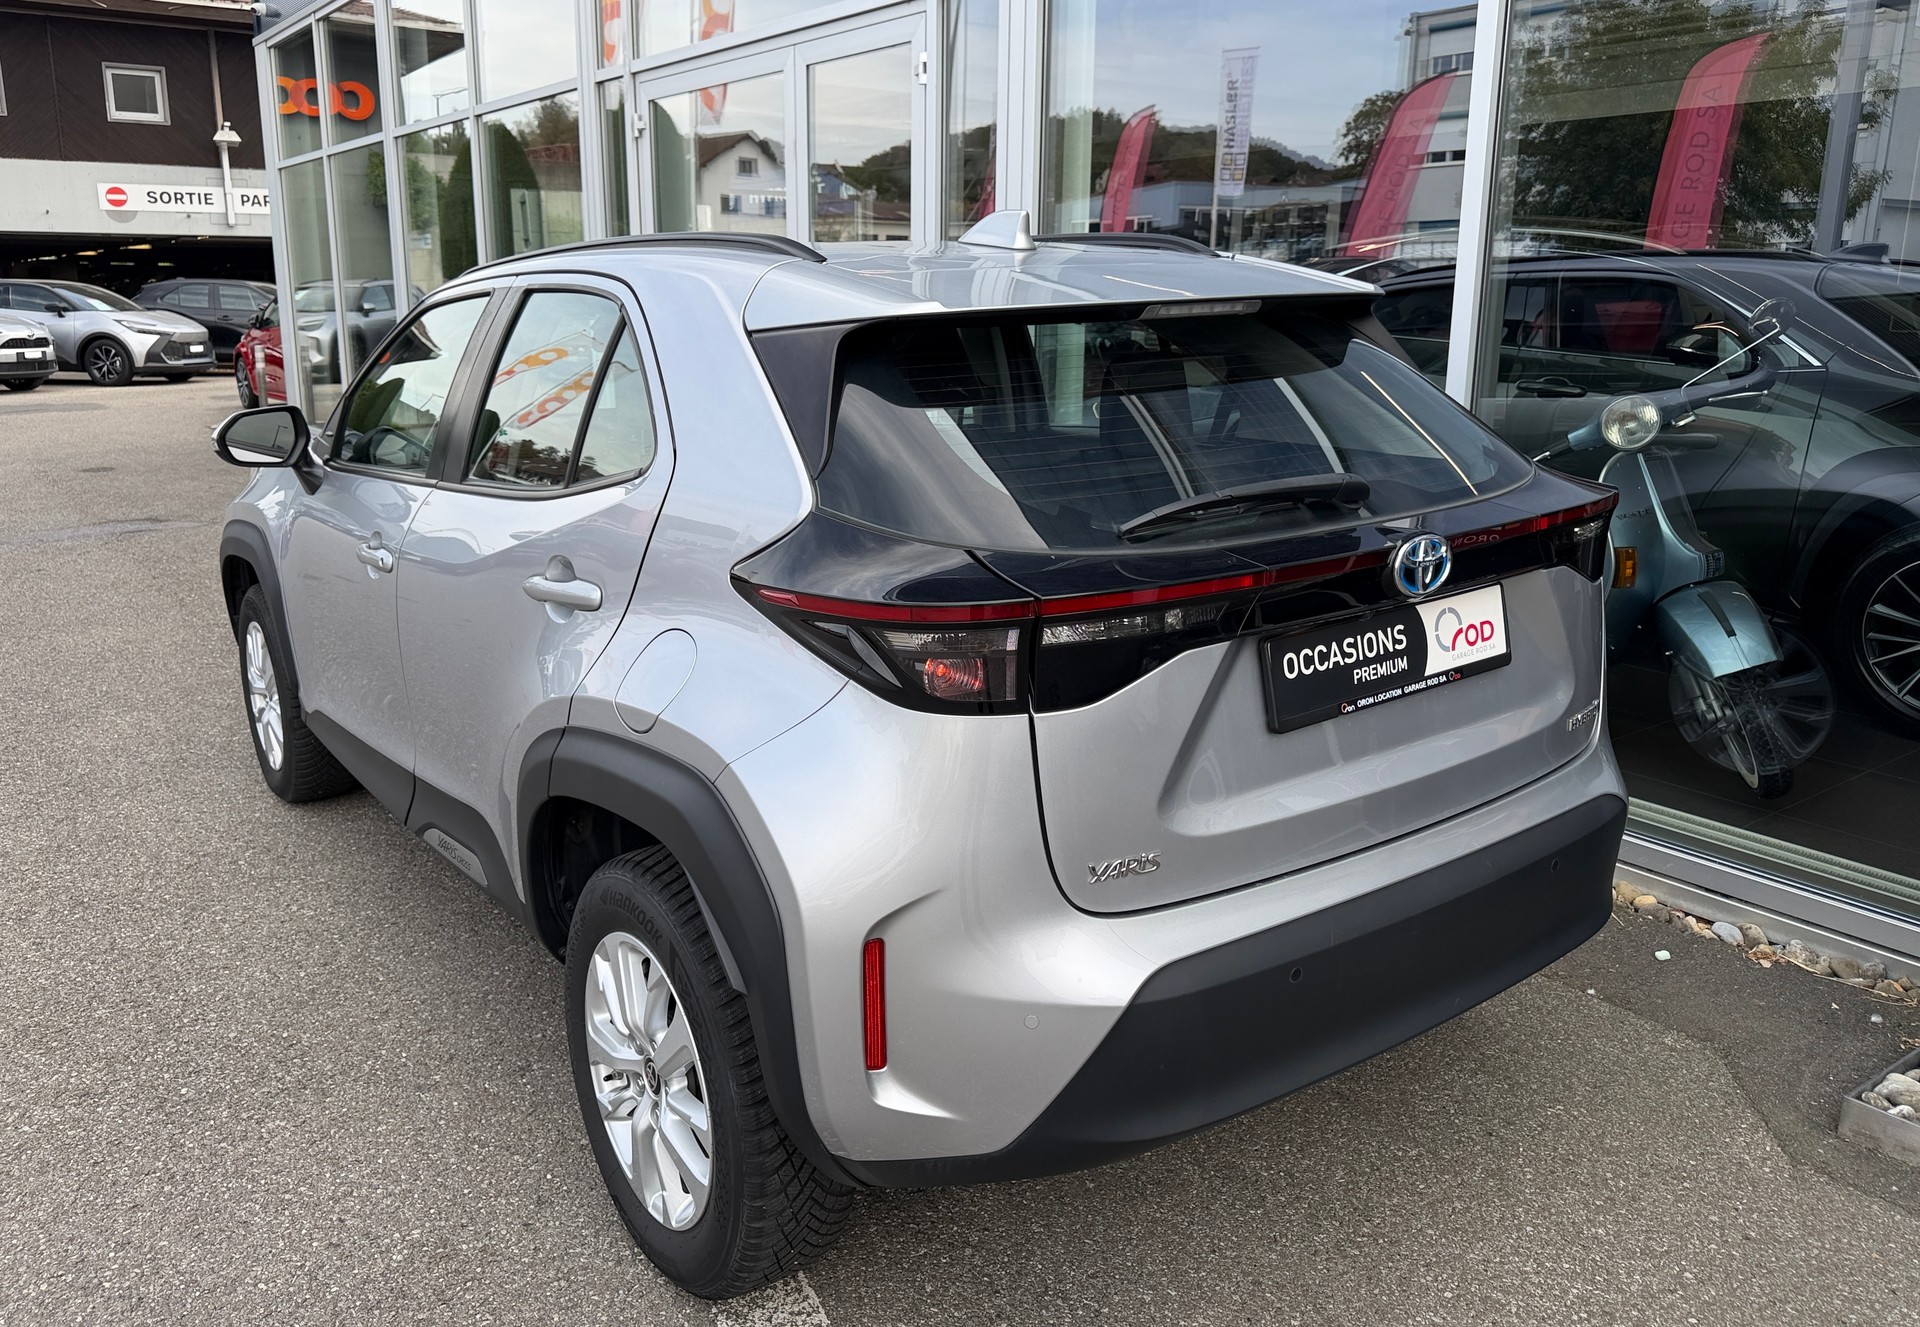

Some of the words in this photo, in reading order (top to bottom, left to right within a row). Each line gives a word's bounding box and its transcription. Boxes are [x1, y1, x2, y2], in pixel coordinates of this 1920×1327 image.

[1222, 79, 1239, 149] HASLER
[1680, 131, 1710, 191] ROD
[1696, 84, 1723, 120] SA
[146, 190, 215, 206] SORTIE
[1384, 155, 1411, 201] ROD
[1282, 624, 1408, 680] OCCASIONS
[1353, 655, 1409, 685] PREMIUM
[1452, 649, 1475, 662] GARAGE
[1475, 644, 1488, 657] ROD
[1488, 643, 1497, 652] SA
[1357, 696, 1375, 708] ORON
[1375, 688, 1403, 703] LOCATION
[1403, 681, 1427, 694] GARAGE
[1427, 677, 1439, 687] ROD
[1439, 674, 1447, 683] SA
